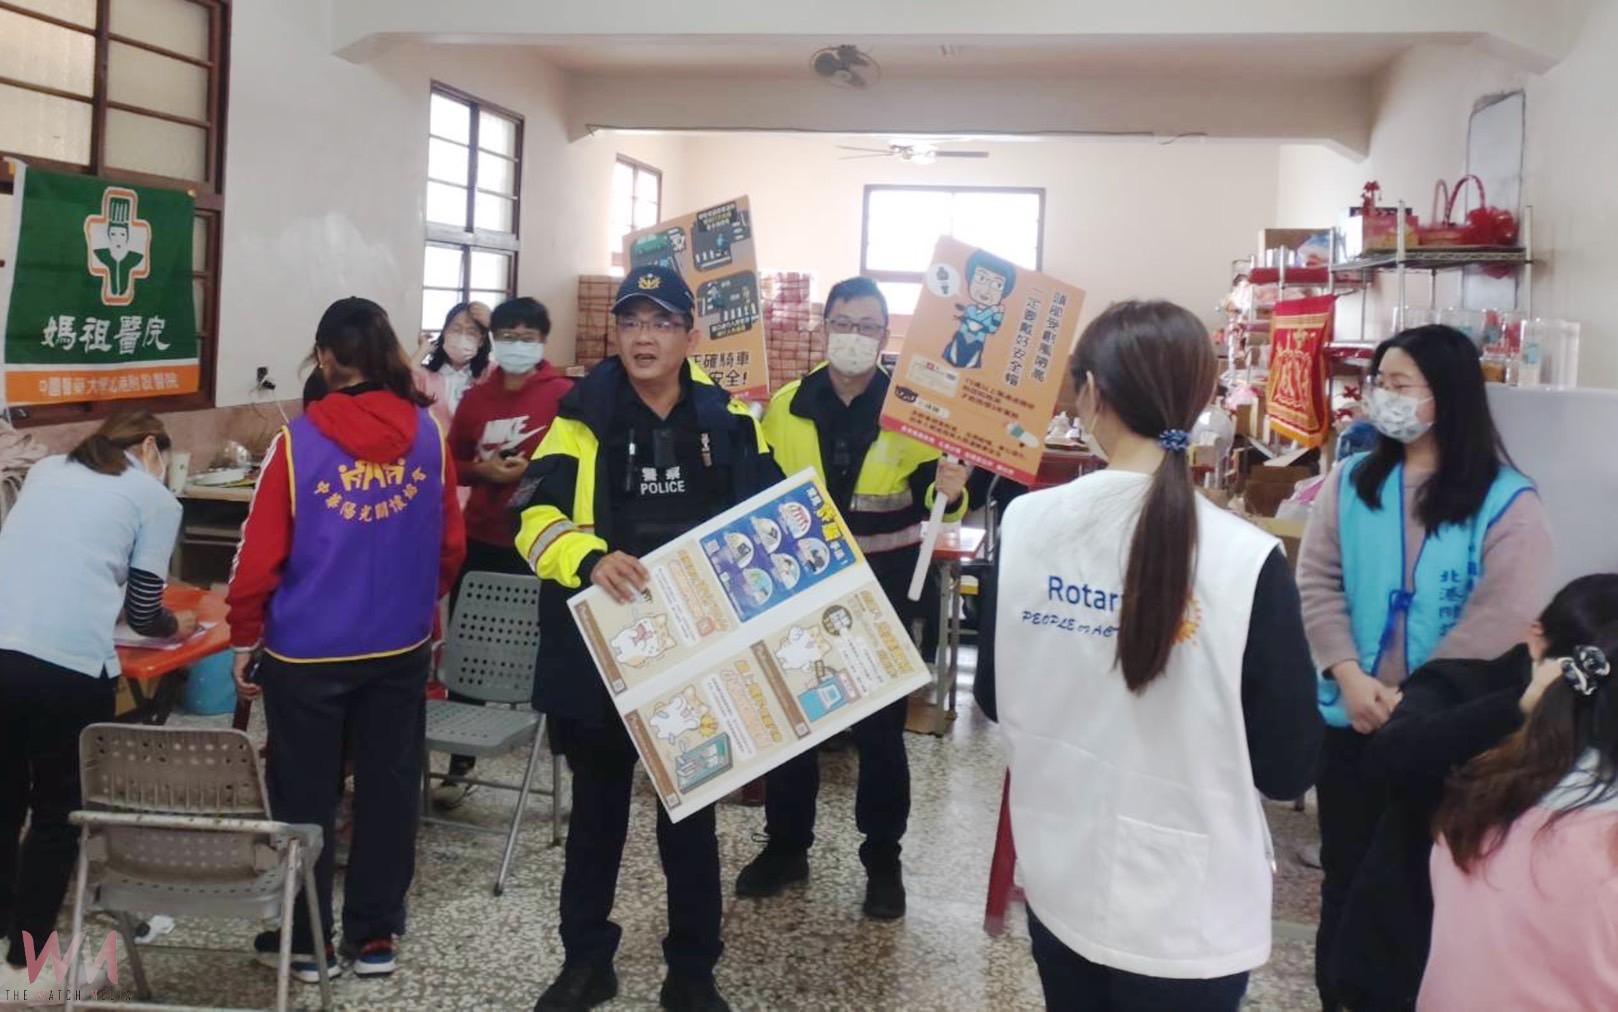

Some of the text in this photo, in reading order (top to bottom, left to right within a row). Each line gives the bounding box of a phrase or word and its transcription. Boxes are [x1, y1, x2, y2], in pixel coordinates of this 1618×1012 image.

[40, 315, 171, 355] 媽祖醫院
[640, 480, 686, 495] POLICE
[1047, 575, 1122, 612] Rotar
[1022, 610, 1075, 631] PEOPLE
